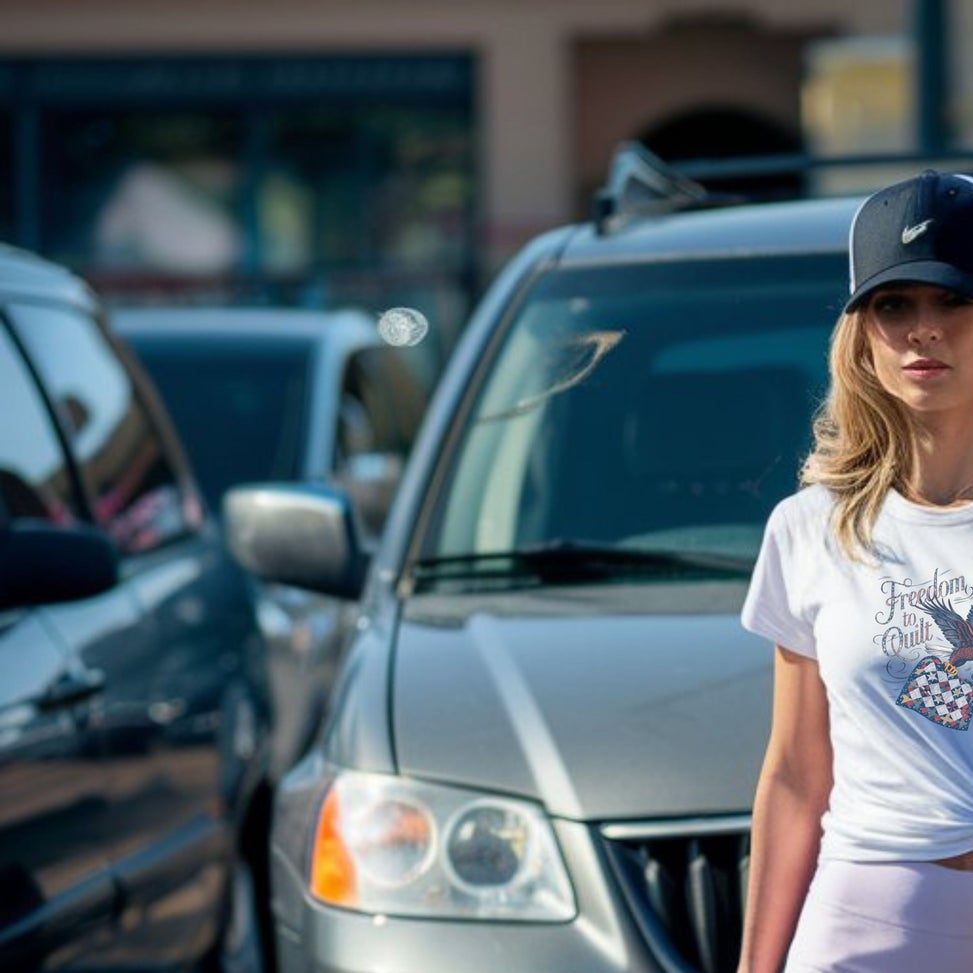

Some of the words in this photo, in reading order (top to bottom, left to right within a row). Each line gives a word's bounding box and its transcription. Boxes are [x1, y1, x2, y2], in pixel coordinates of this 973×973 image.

[875, 568, 973, 624] Freedom
[873, 618, 933, 661] Quilt
[903, 611, 917, 627] to
